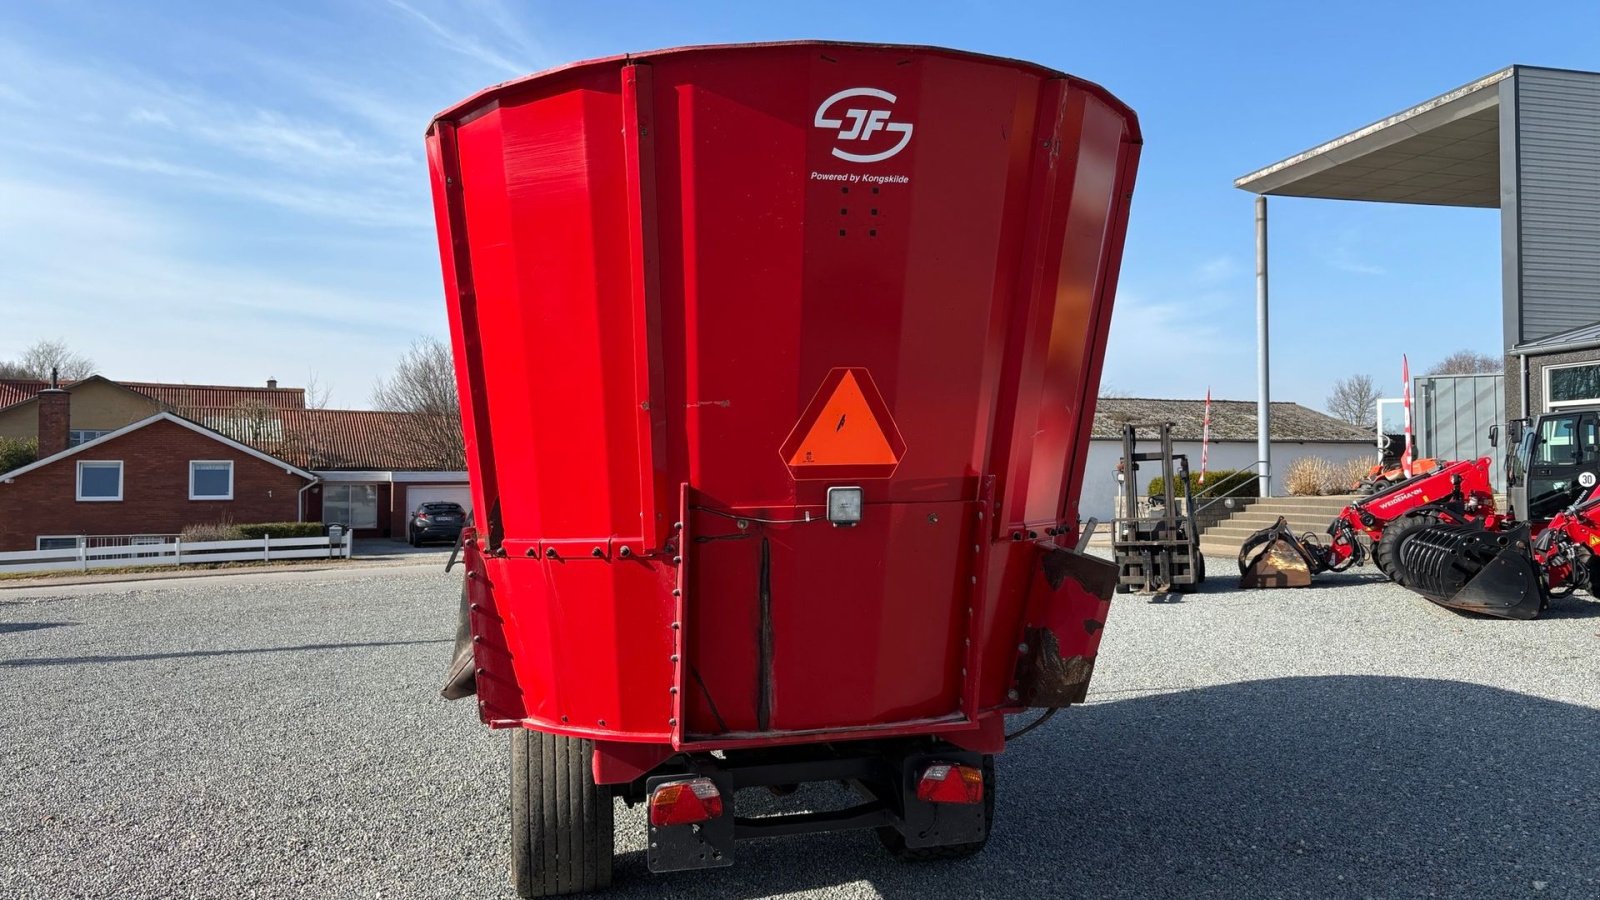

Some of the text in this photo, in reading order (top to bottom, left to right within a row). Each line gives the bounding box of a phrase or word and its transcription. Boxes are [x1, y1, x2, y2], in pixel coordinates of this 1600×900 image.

[837, 108, 892, 141] JF
[810, 171, 909, 184] Powered by Kongskilde
[1582, 474, 1593, 484] 30
[1379, 487, 1422, 509] WEIDEMANN
